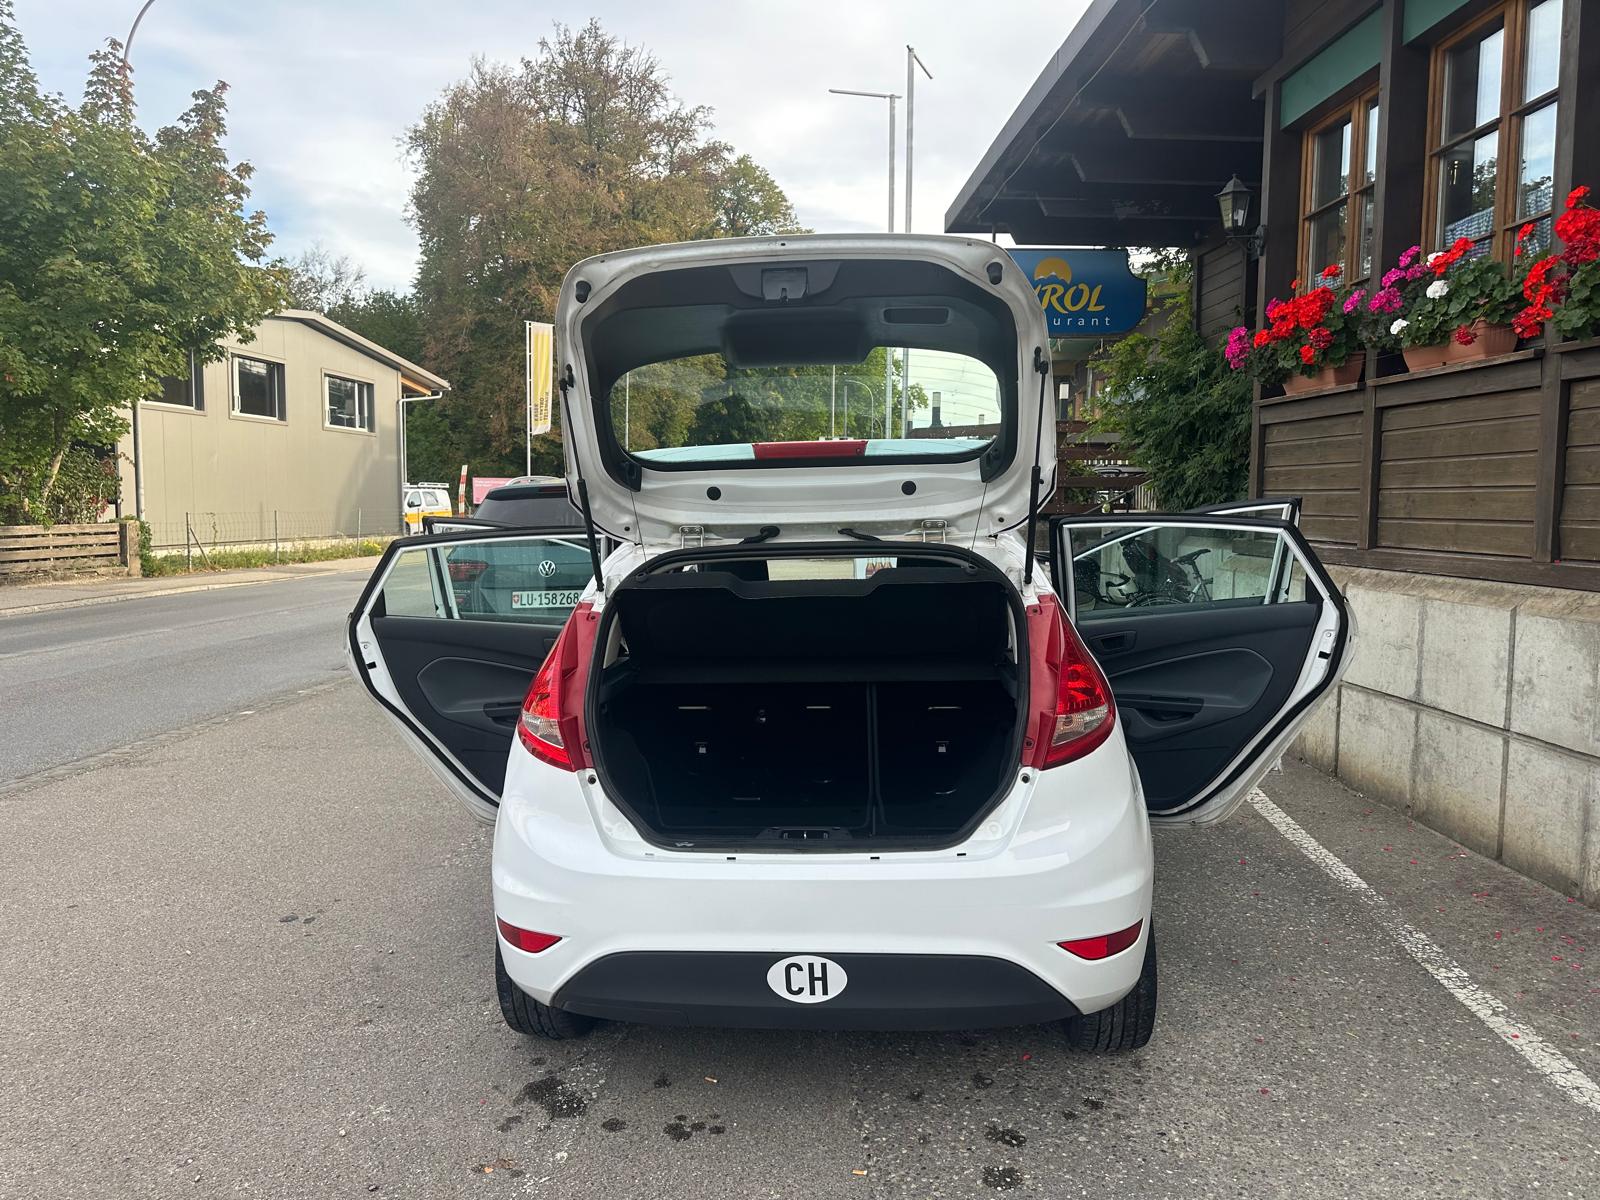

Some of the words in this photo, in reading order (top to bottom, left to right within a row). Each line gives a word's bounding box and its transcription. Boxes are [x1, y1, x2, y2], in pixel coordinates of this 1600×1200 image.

[1034, 283, 1106, 314] ROL
[1053, 316, 1111, 326] urant
[784, 962, 829, 996] CH
